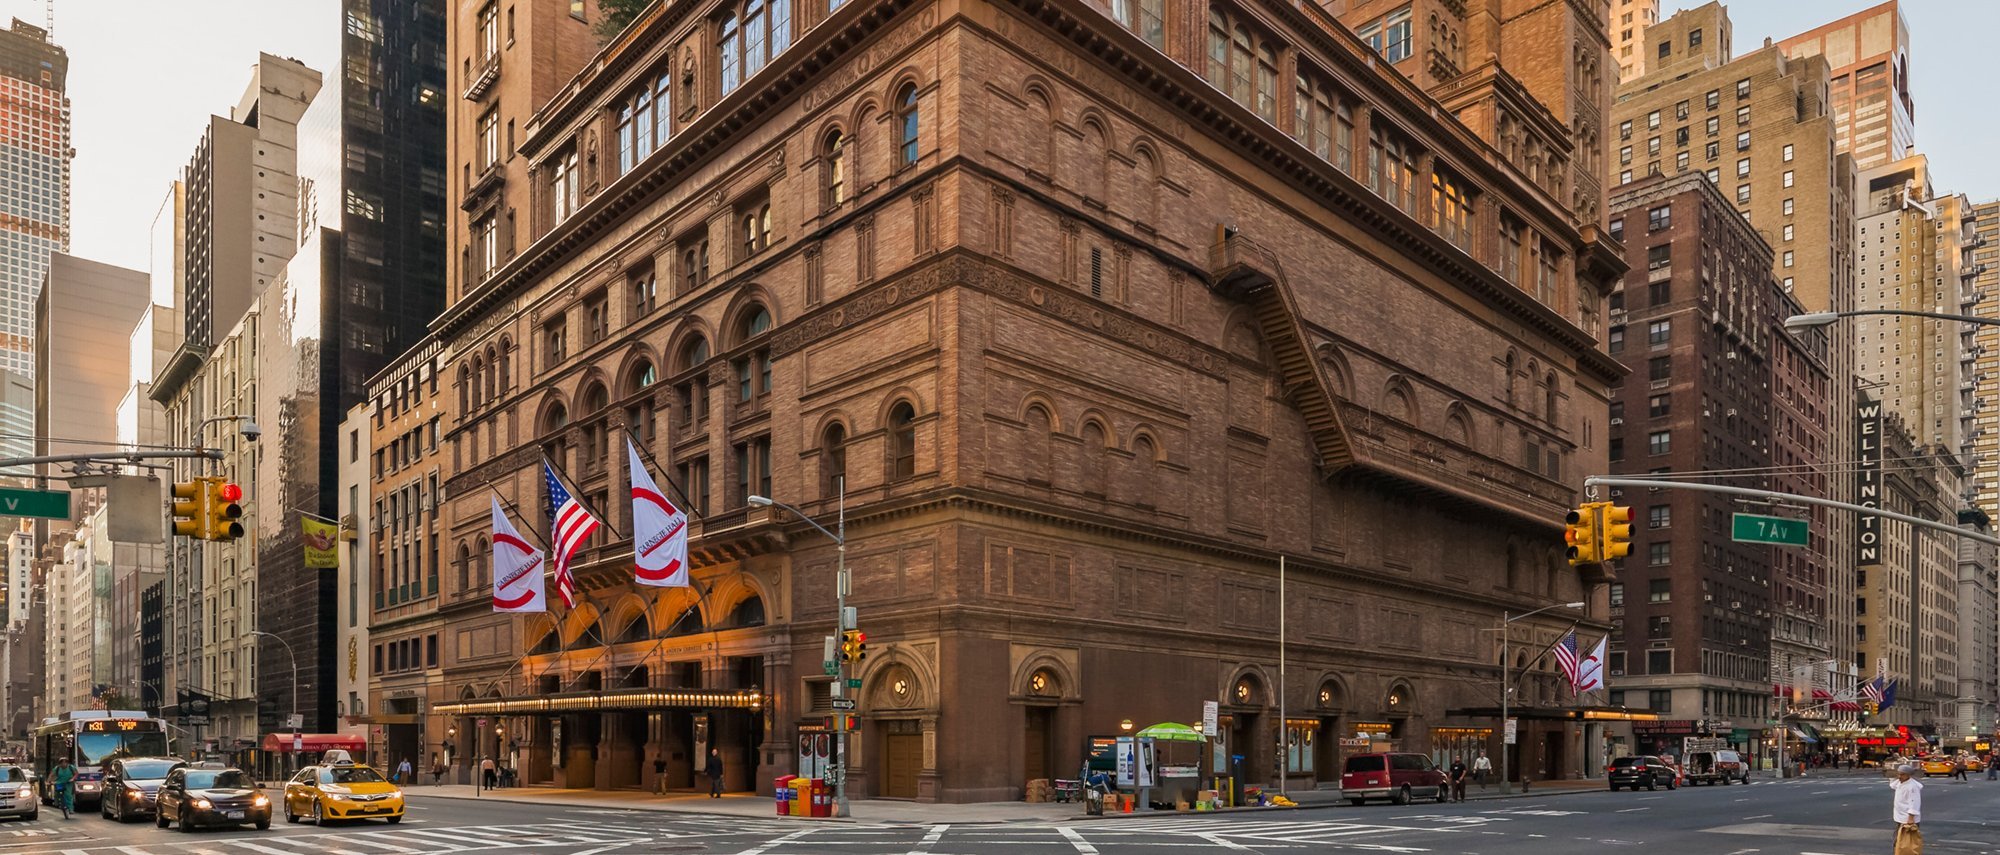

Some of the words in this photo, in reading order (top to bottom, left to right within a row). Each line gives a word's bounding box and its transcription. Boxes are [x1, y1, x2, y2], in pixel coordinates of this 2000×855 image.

[1859, 405, 1880, 560] WELLINGTON
[638, 529, 667, 554] CARNEGIE
[665, 517, 685, 533] HALL
[1757, 521, 1766, 537] 7
[1769, 523, 1788, 539] Av
[496, 566, 525, 588] CARNEGIE
[89, 721, 104, 731] M31
